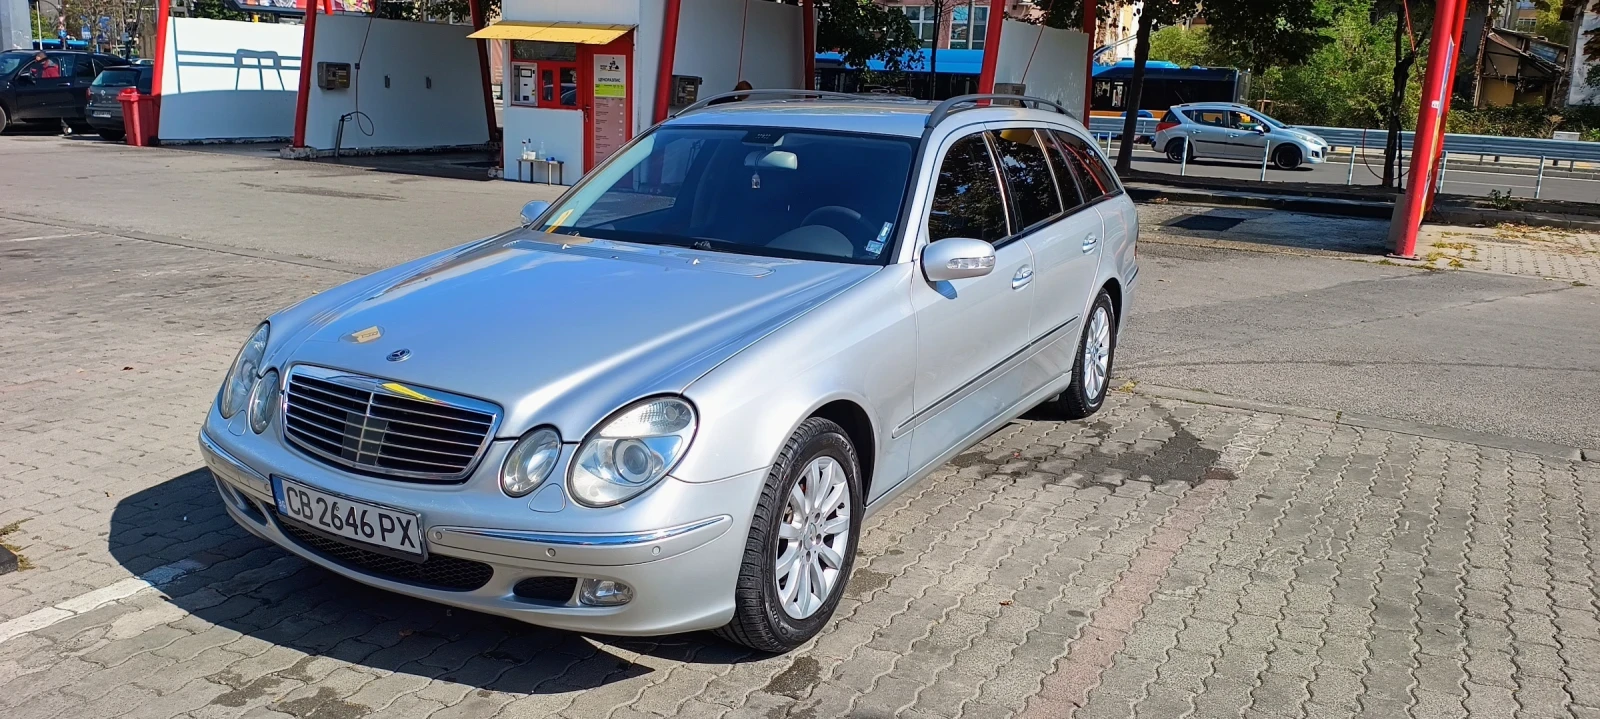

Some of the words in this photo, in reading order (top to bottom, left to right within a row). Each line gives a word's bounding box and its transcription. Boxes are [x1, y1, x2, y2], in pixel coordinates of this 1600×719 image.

[286, 486, 313, 520] CB
[316, 497, 375, 539] 2646
[378, 512, 416, 549] PX
